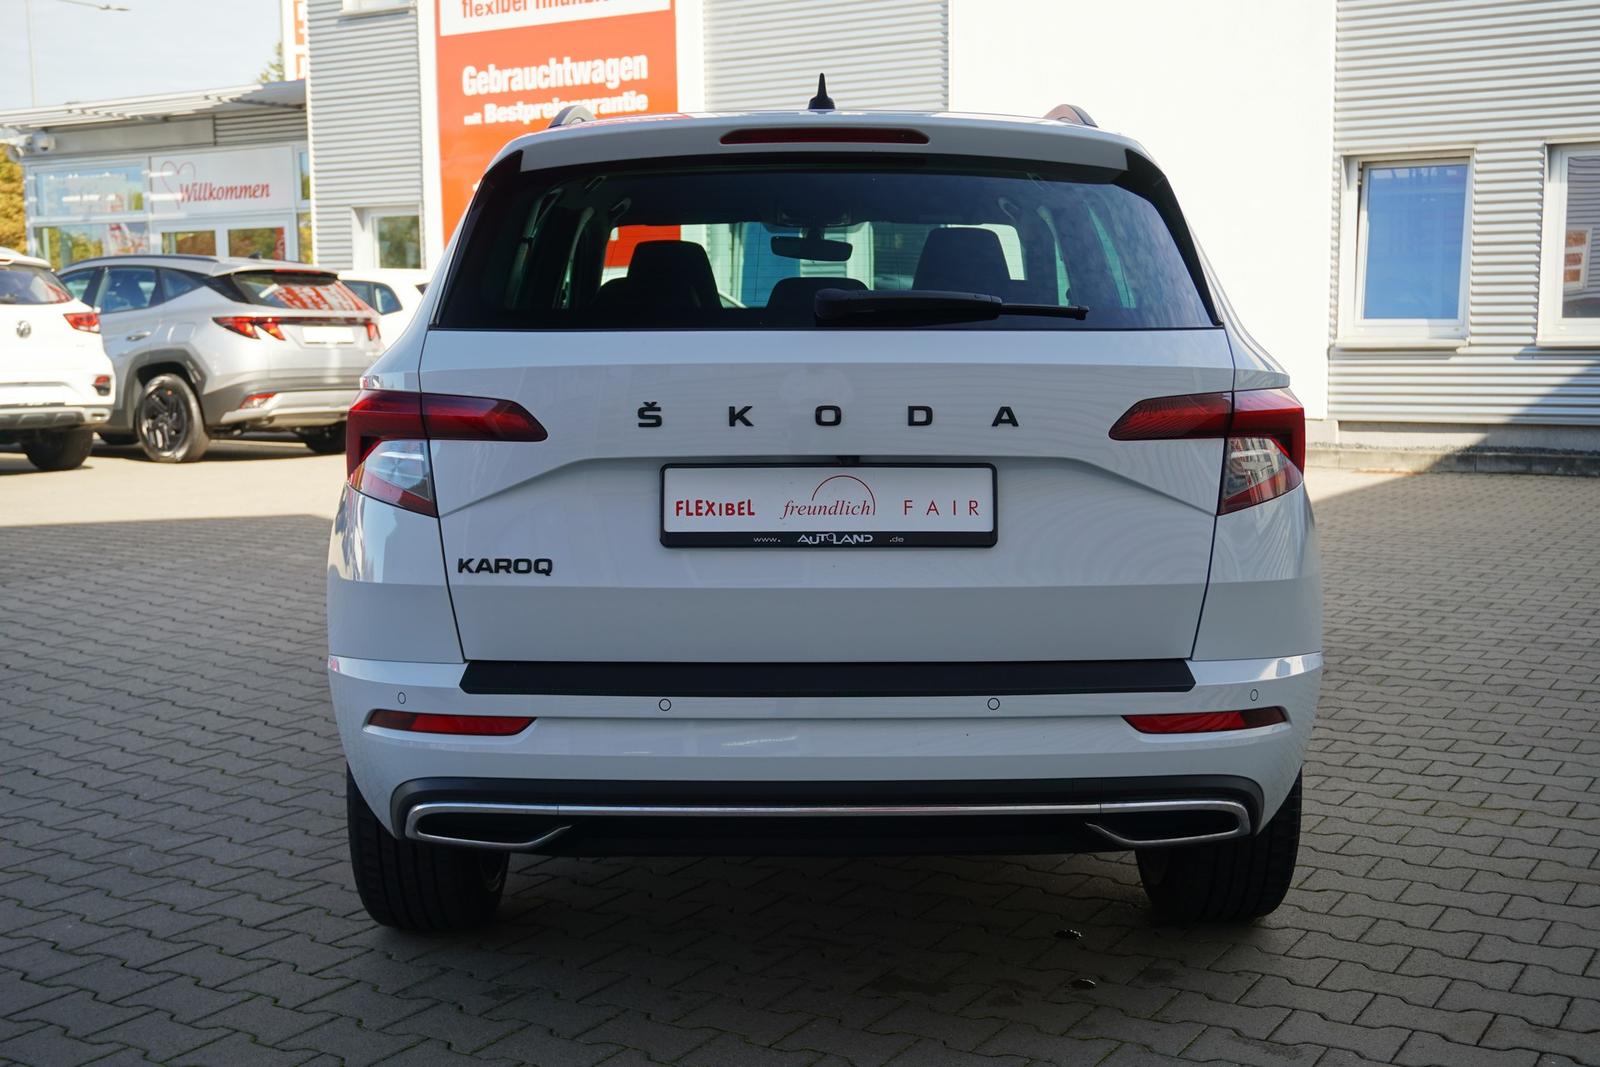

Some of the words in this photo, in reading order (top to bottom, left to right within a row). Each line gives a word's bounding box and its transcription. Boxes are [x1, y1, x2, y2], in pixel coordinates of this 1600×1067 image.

[462, 54, 649, 96] Gebrauchtwagen
[180, 182, 270, 203] Willkommen
[637, 401, 1019, 428] ŠKODA
[675, 499, 756, 517] FLEXIBEL
[779, 499, 871, 520] freundlich
[904, 500, 980, 516] FAIR
[797, 532, 874, 545] AUTOLAND
[457, 558, 553, 576] KAROQ
